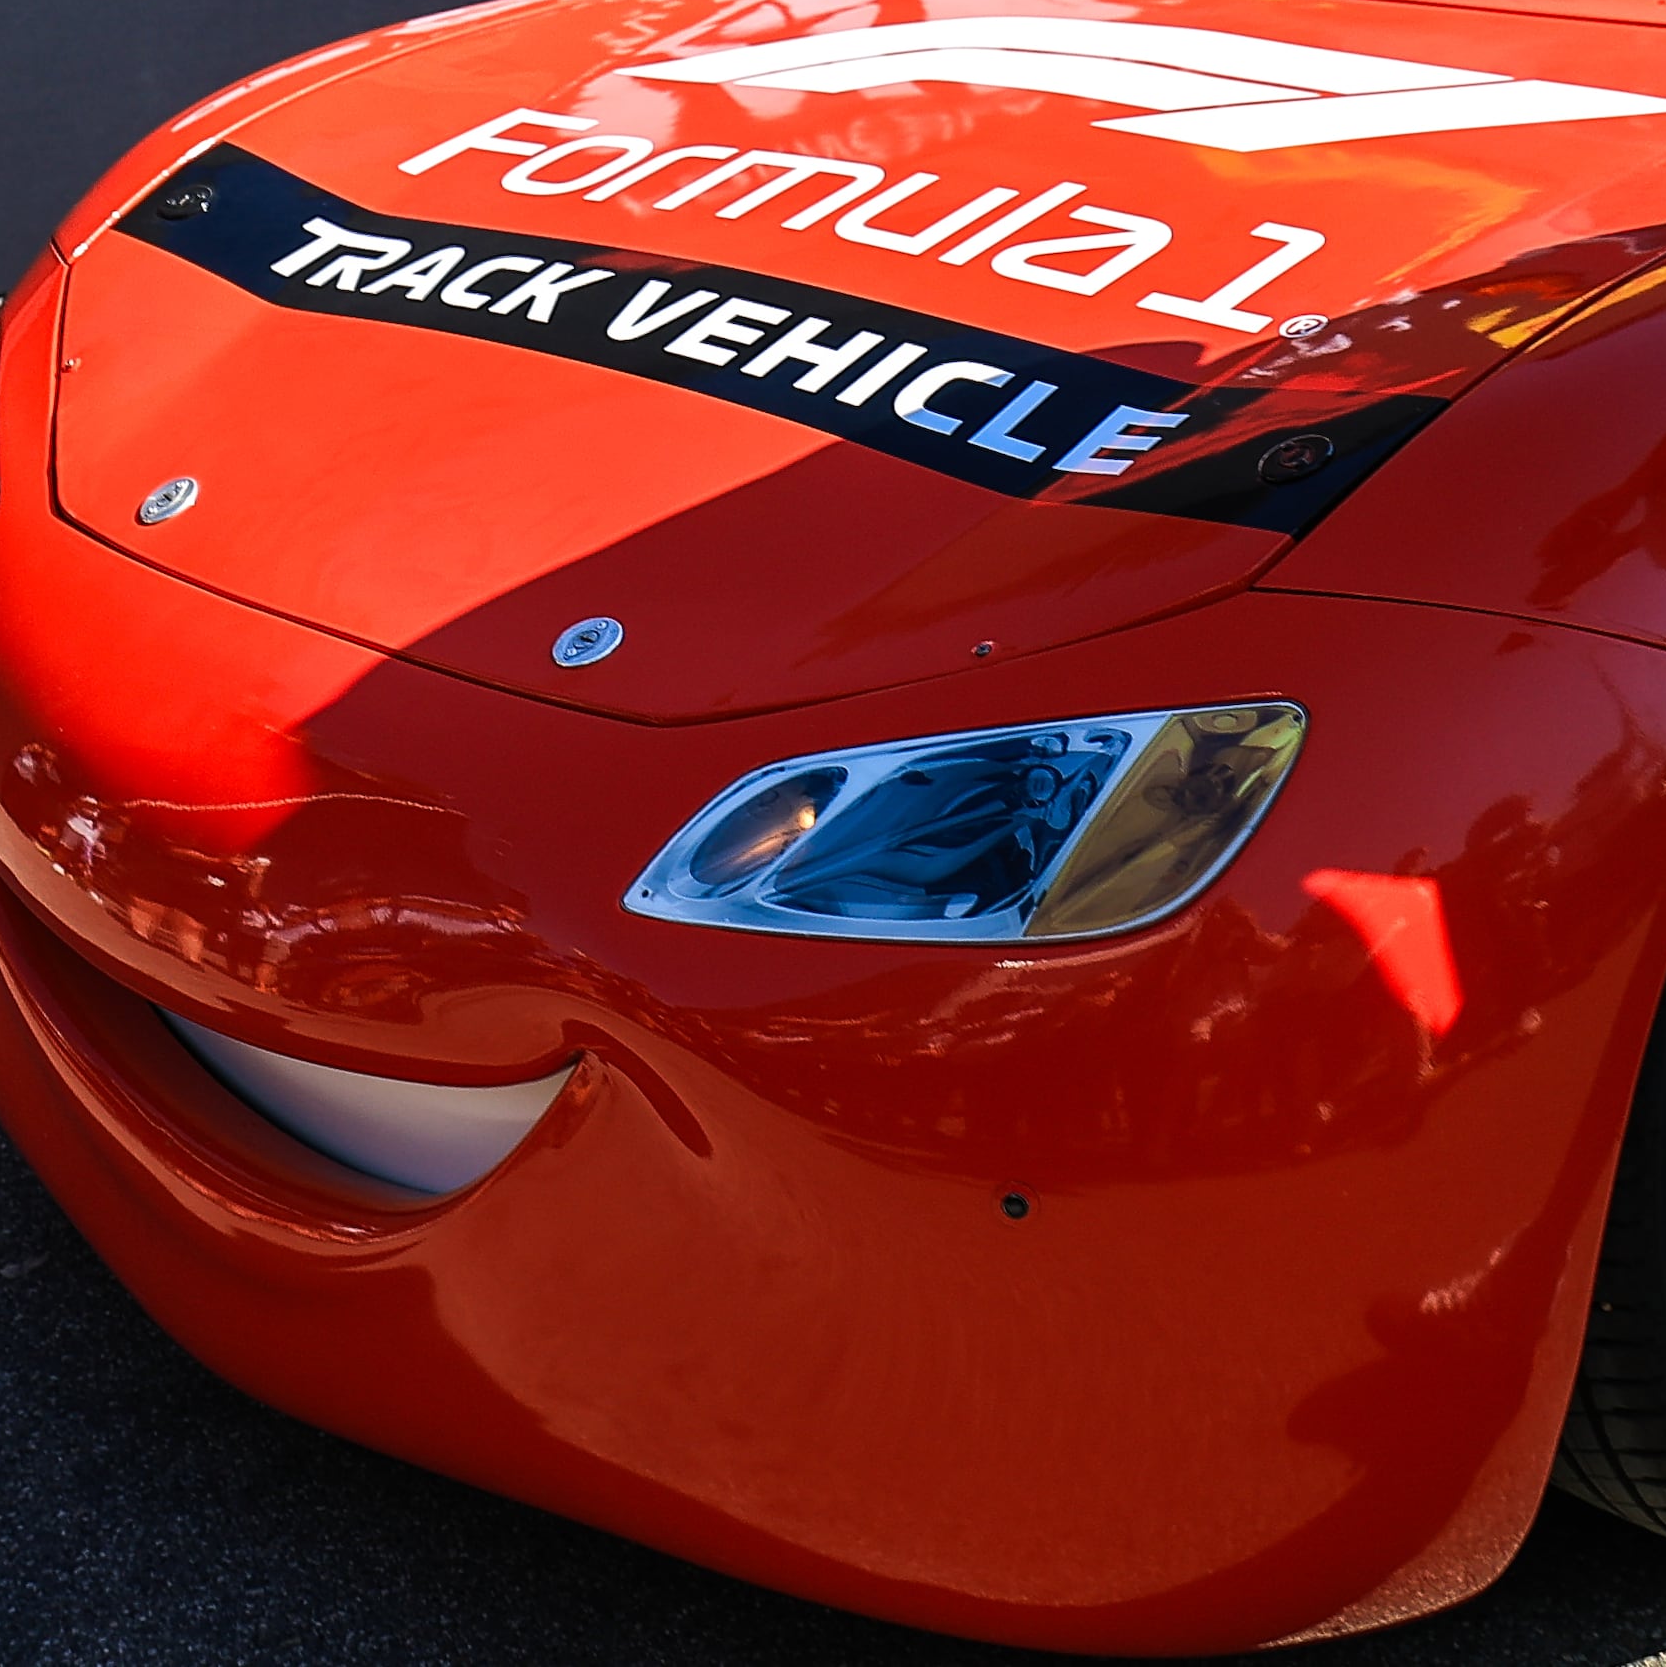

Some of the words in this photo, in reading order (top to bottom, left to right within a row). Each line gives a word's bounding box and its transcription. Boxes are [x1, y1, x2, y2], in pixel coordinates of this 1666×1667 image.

[396, 106, 1173, 297] Formula
[1135, 220, 1328, 334] 1
[269, 215, 617, 325] TRACK
[605, 278, 1192, 477] VEHICLE
